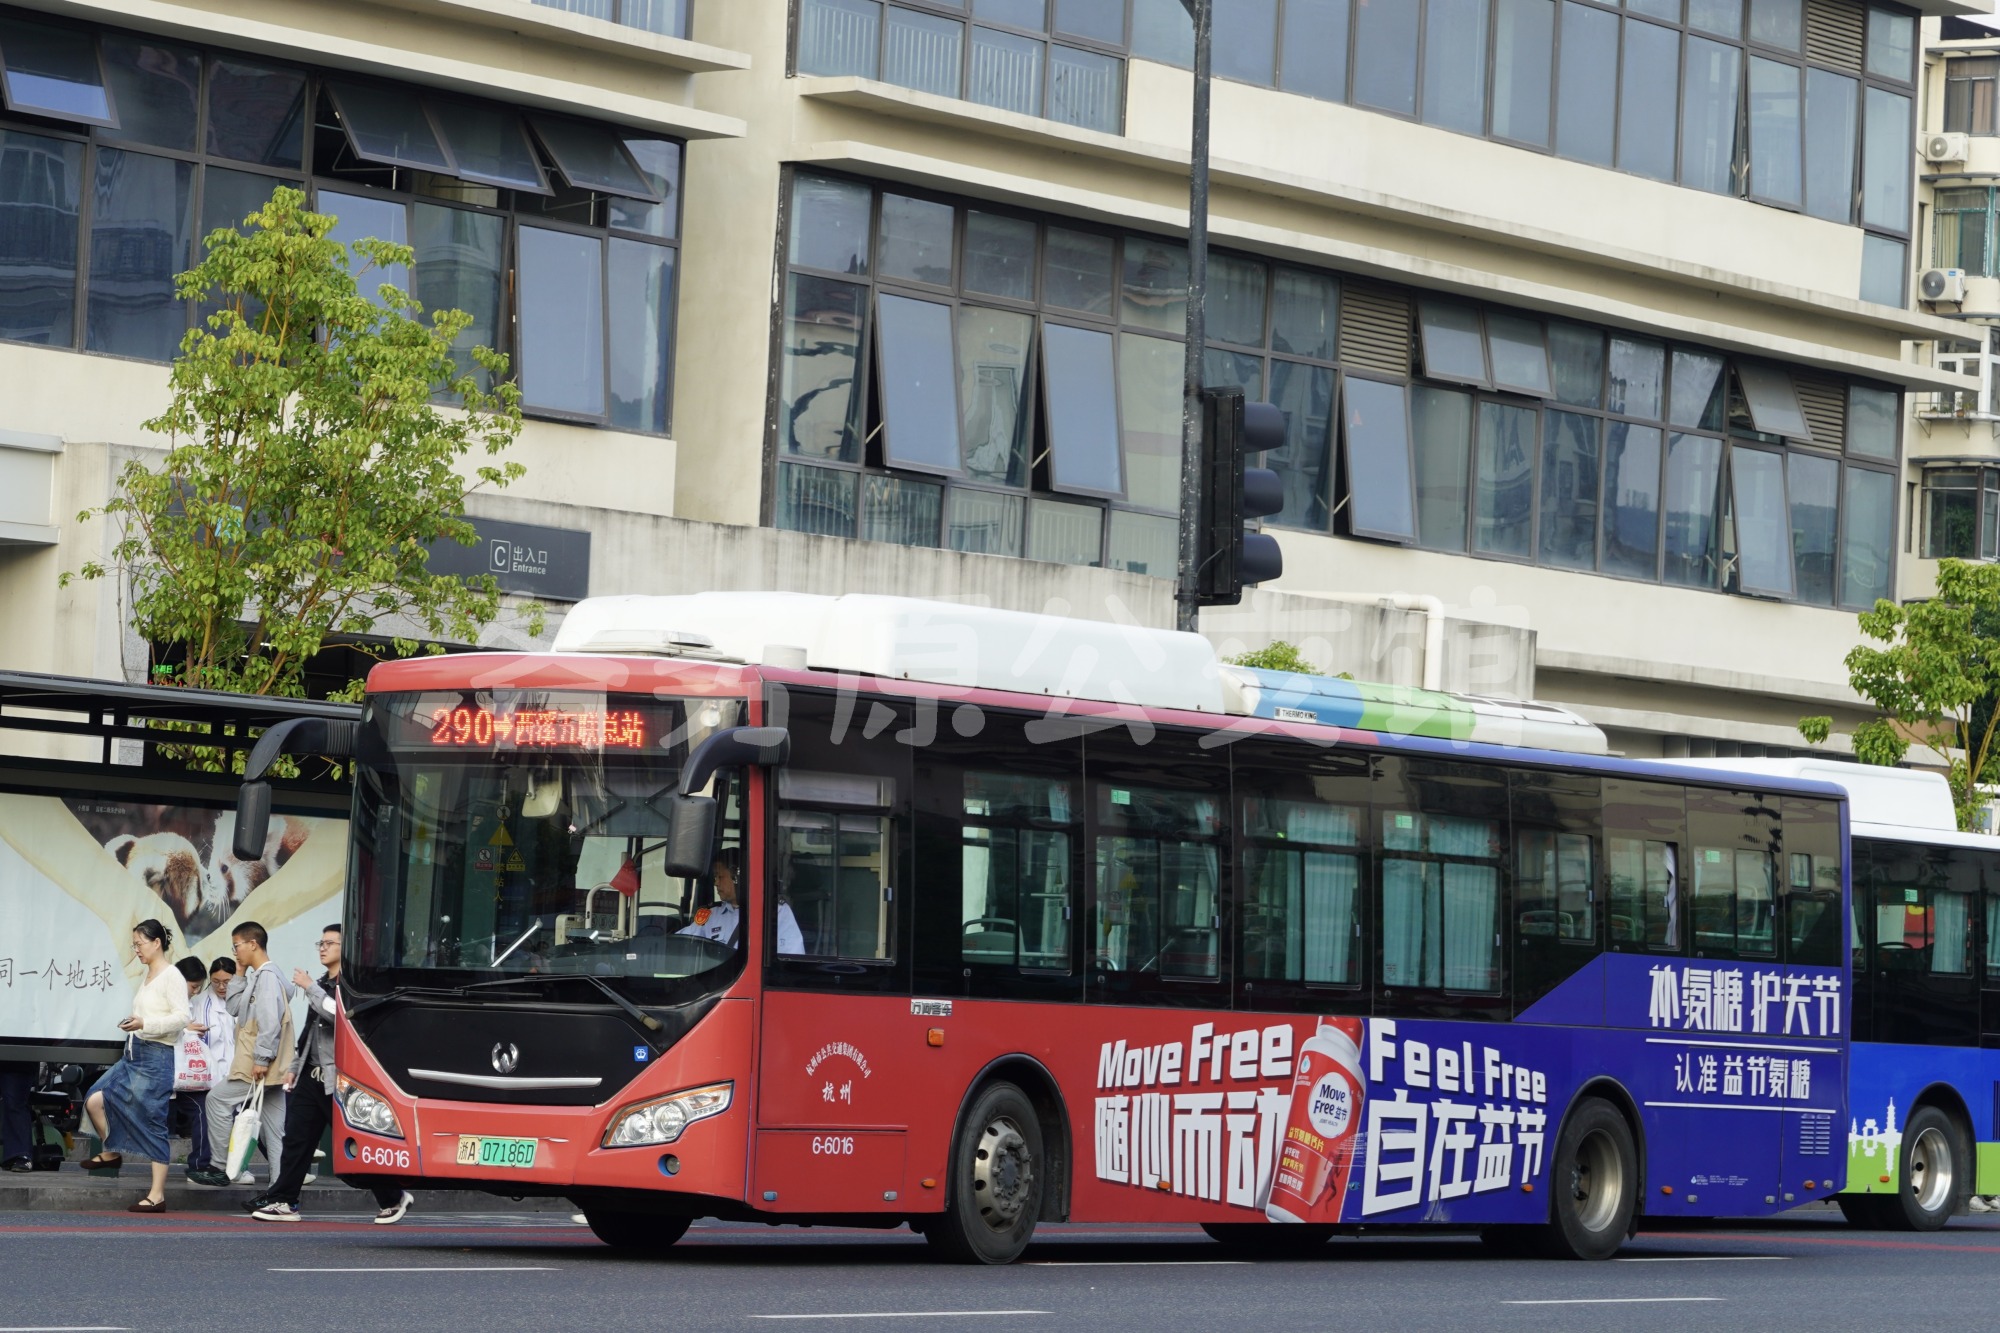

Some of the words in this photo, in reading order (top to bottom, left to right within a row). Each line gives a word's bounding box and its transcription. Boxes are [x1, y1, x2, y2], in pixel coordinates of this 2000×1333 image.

[494, 546, 506, 566] C
[513, 545, 548, 565] 出入口
[512, 562, 546, 575] Entrance
[1282, 709, 1304, 718] THERMO
[1305, 711, 1317, 720] KING
[432, 709, 492, 744] 290
[0, 957, 114, 993] 同一个地球
[1649, 964, 1743, 1032] 补氨糖
[1750, 970, 1841, 1036] 护关节
[1097, 1039, 1183, 1088] Move
[1189, 1022, 1293, 1082] Free
[1368, 1017, 1474, 1094] Feel
[1484, 1047, 1547, 1103] Free
[822, 1080, 852, 1105] 杭州
[1319, 1084, 1346, 1103] Move
[1313, 1100, 1335, 1116] Free
[1334, 1106, 1347, 1121] 益节
[361, 1146, 410, 1168] 6-6016
[812, 1137, 854, 1155] 6-6016
[1095, 1087, 1292, 1208] 随心而动
[1362, 1088, 1548, 1216] 自在益节
